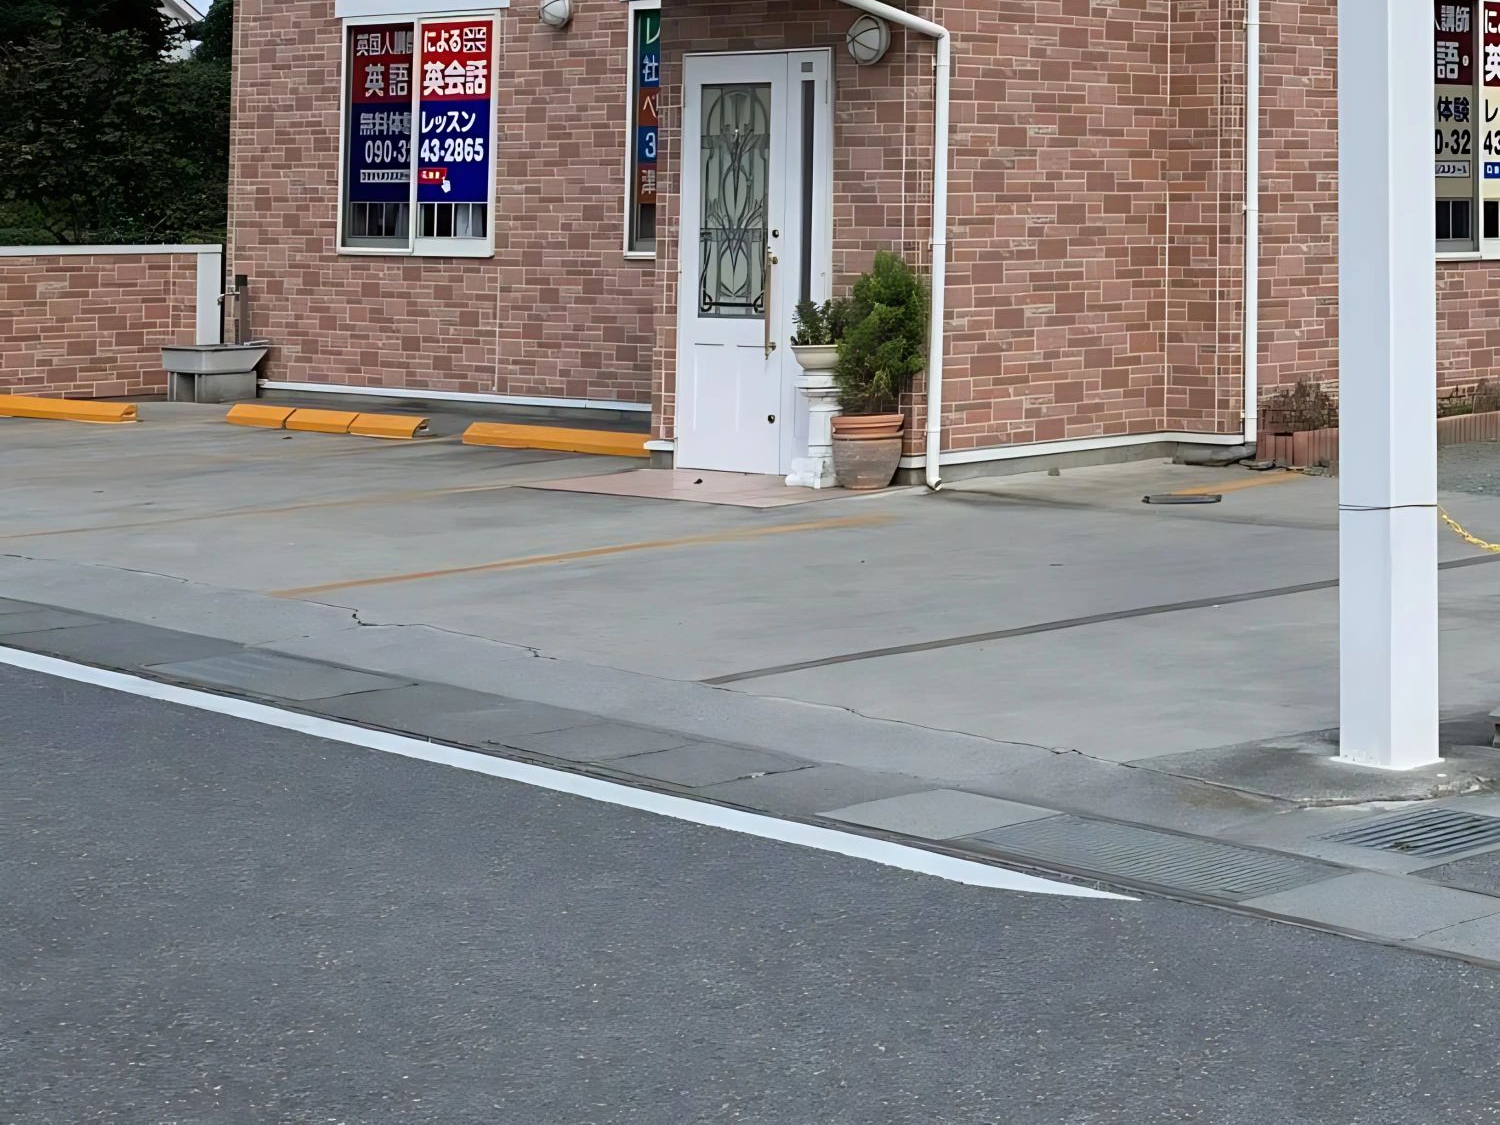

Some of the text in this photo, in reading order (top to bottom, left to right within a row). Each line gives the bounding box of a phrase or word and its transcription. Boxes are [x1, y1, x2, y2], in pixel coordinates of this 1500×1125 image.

[1434, 5, 1470, 33] 講師
[423, 29, 461, 53] による
[364, 59, 488, 97] 英語 英会話
[421, 110, 476, 134] レッスン
[645, 132, 656, 158] 3
